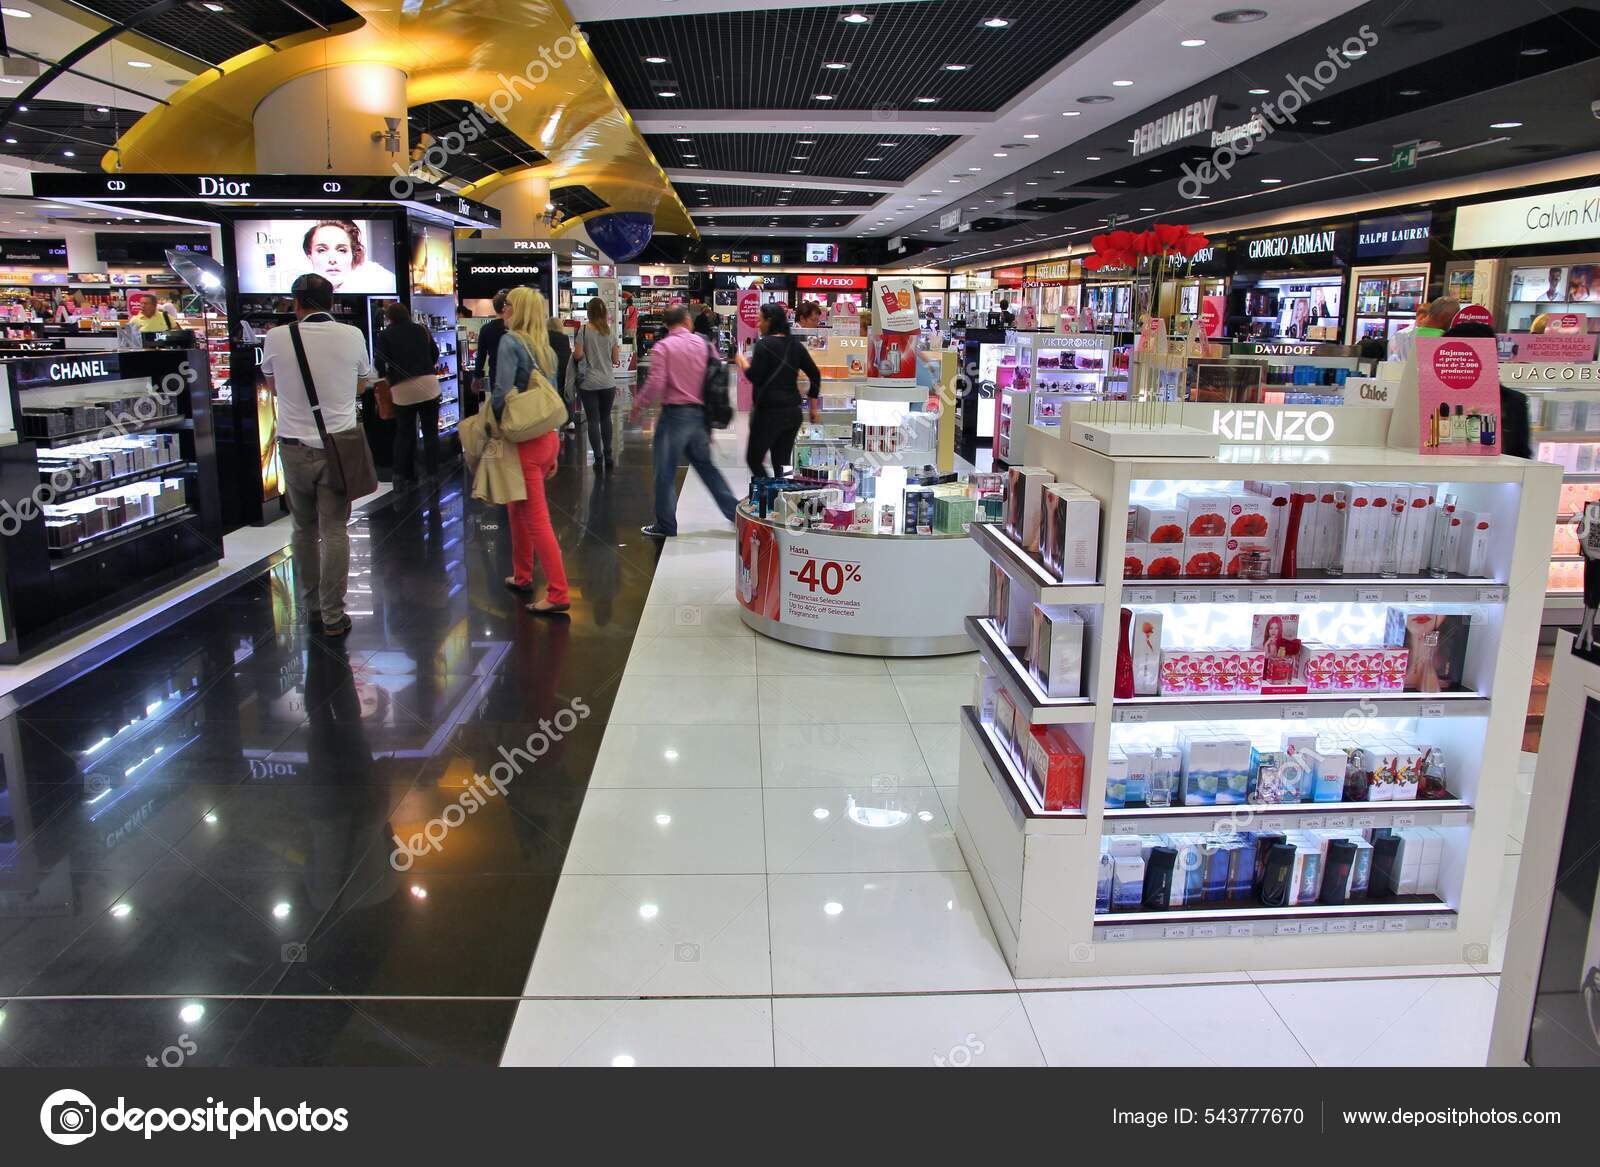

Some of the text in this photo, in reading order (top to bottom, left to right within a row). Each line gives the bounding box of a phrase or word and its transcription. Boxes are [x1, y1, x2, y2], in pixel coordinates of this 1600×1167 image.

[1133, 95, 1218, 156] PERFUMERY
[107, 181, 125, 190] CD
[199, 177, 250, 196] Dior
[323, 183, 341, 192] CD
[1526, 202, 1578, 230] Calvin
[1359, 226, 1430, 245] RALPH LAUREN
[514, 241, 551, 249] PRADA
[1249, 231, 1336, 258] GIORGIO ARMANI
[471, 265, 539, 275] paco rabanne
[812, 277, 854, 286] SHISEIDO
[1255, 344, 1316, 355] DAVIDOFF
[1439, 349, 1473, 357] Bajamos
[50, 361, 109, 381] CHANEL
[1360, 383, 1388, 402] Chloé
[1212, 410, 1335, 442] KENZO
[789, 545, 809, 555] Hasta
[789, 559, 862, 595] -40%
[788, 591, 819, 603] Fragancias
[788, 602, 798, 610] Up
[804, 603, 817, 612] 40%
[817, 606, 827, 614] off
[827, 607, 855, 617] Selected
[788, 608, 819, 619] Fragrances
